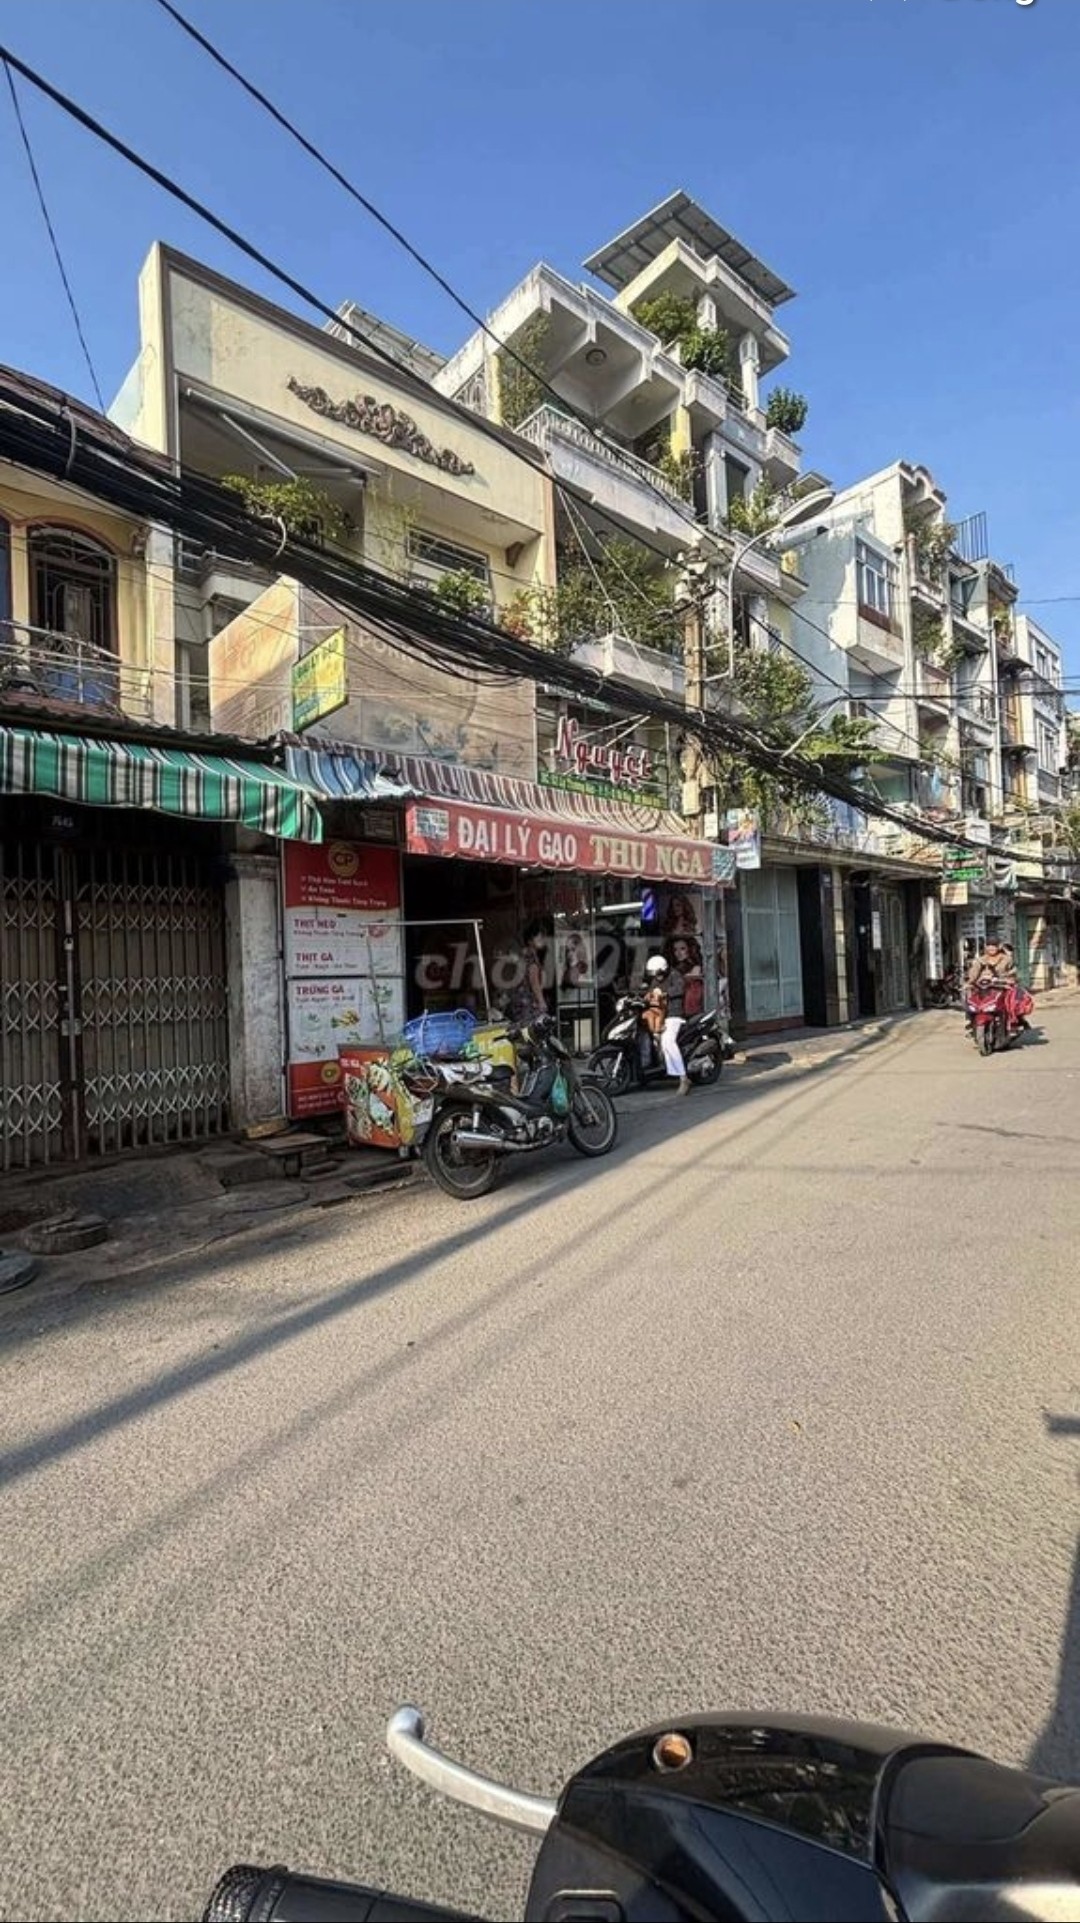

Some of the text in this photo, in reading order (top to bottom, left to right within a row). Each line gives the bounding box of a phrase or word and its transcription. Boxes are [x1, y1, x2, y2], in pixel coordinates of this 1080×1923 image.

[458, 816, 497, 858] ĐẠI
[504, 818, 531, 857] LÝ
[538, 829, 577, 866] GẠO
[590, 833, 648, 873] THU
[655, 843, 711, 879] NGA
